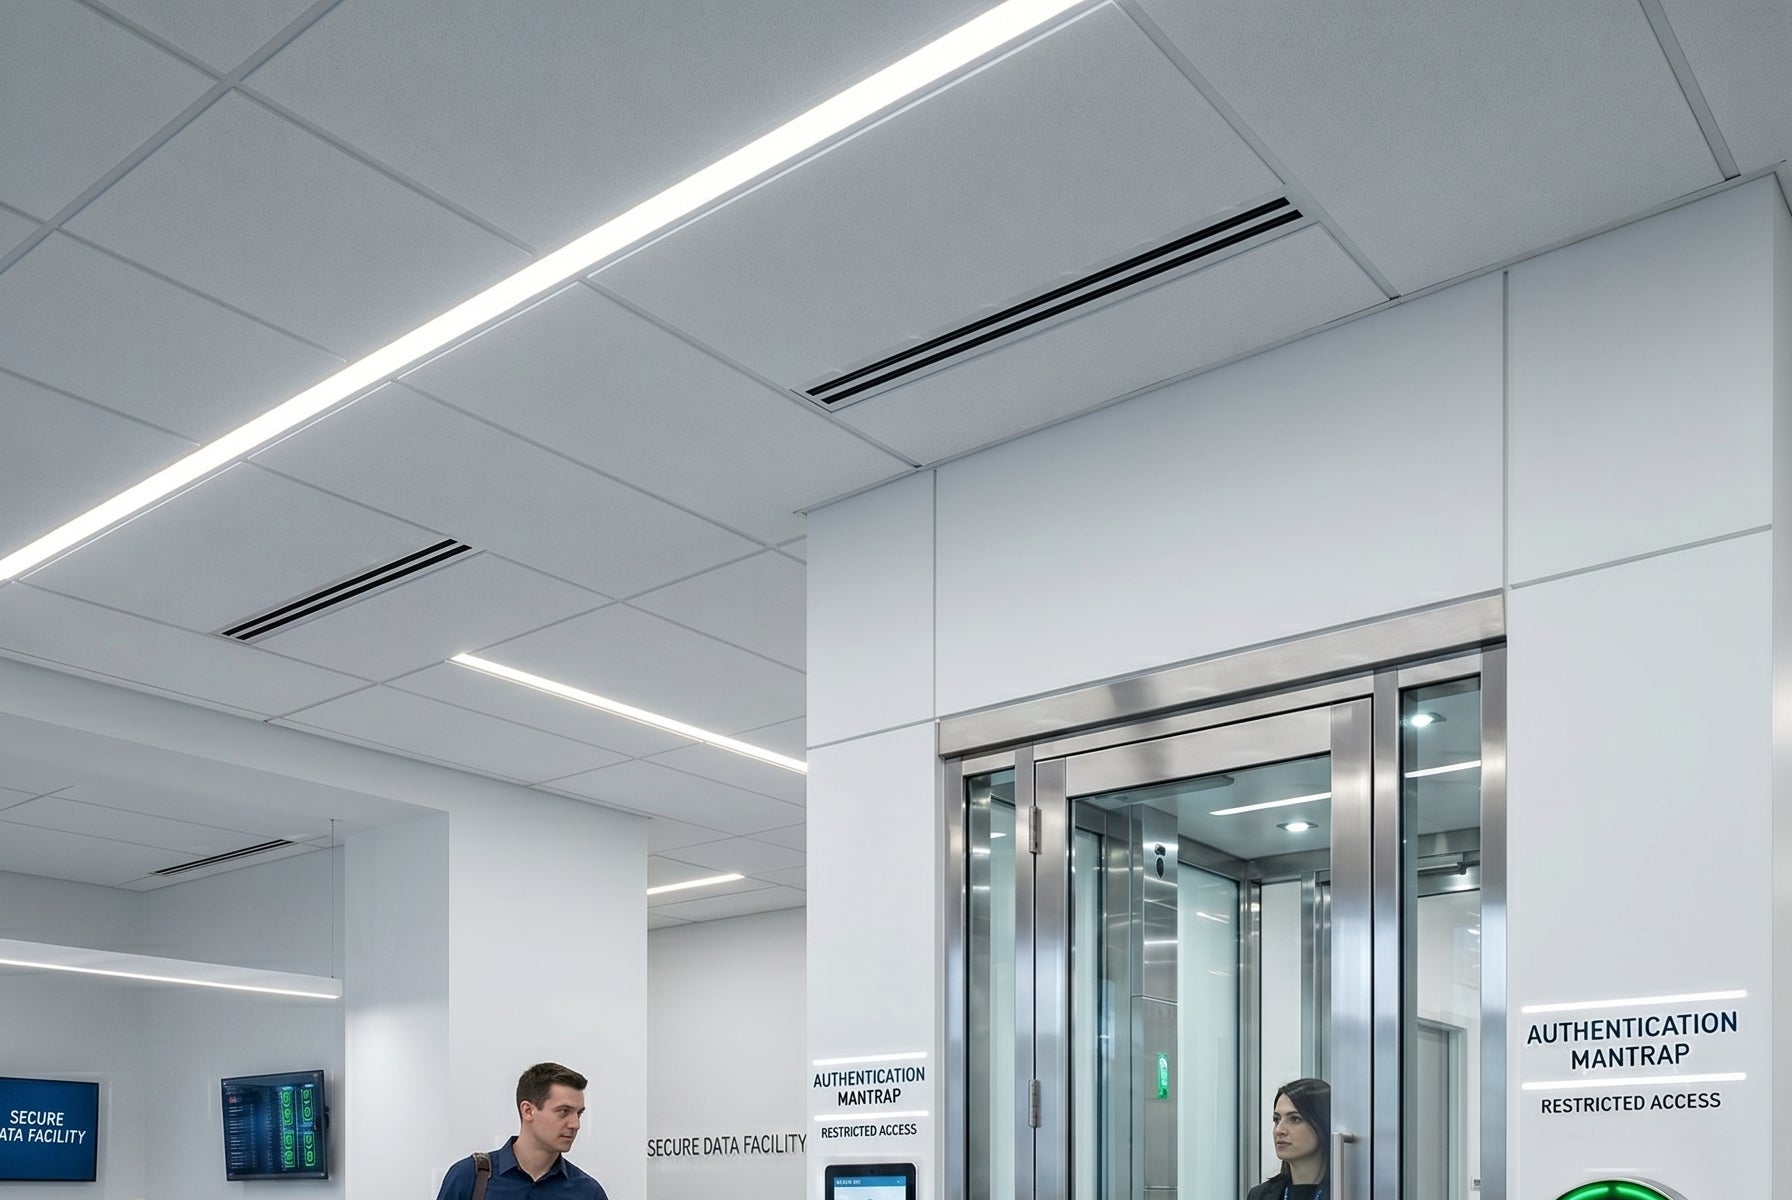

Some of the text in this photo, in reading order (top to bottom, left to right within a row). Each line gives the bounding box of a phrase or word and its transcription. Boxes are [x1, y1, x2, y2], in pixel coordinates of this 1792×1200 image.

[1526, 1011, 1738, 1045] AUTHENTICATION
[1571, 1043, 1690, 1070] MANTRAP
[813, 1066, 925, 1088] AUTHENTICATION
[838, 1088, 902, 1106] MANTRAP
[1540, 1092, 1721, 1114] RESTRICTED ACCESS
[9, 1109, 65, 1127] SECURE
[0, 1127, 87, 1145] ATA FACILITY
[821, 1123, 918, 1139] RESTRICTED ACCESS
[647, 1133, 807, 1157] SECURE DATA FACILITY
